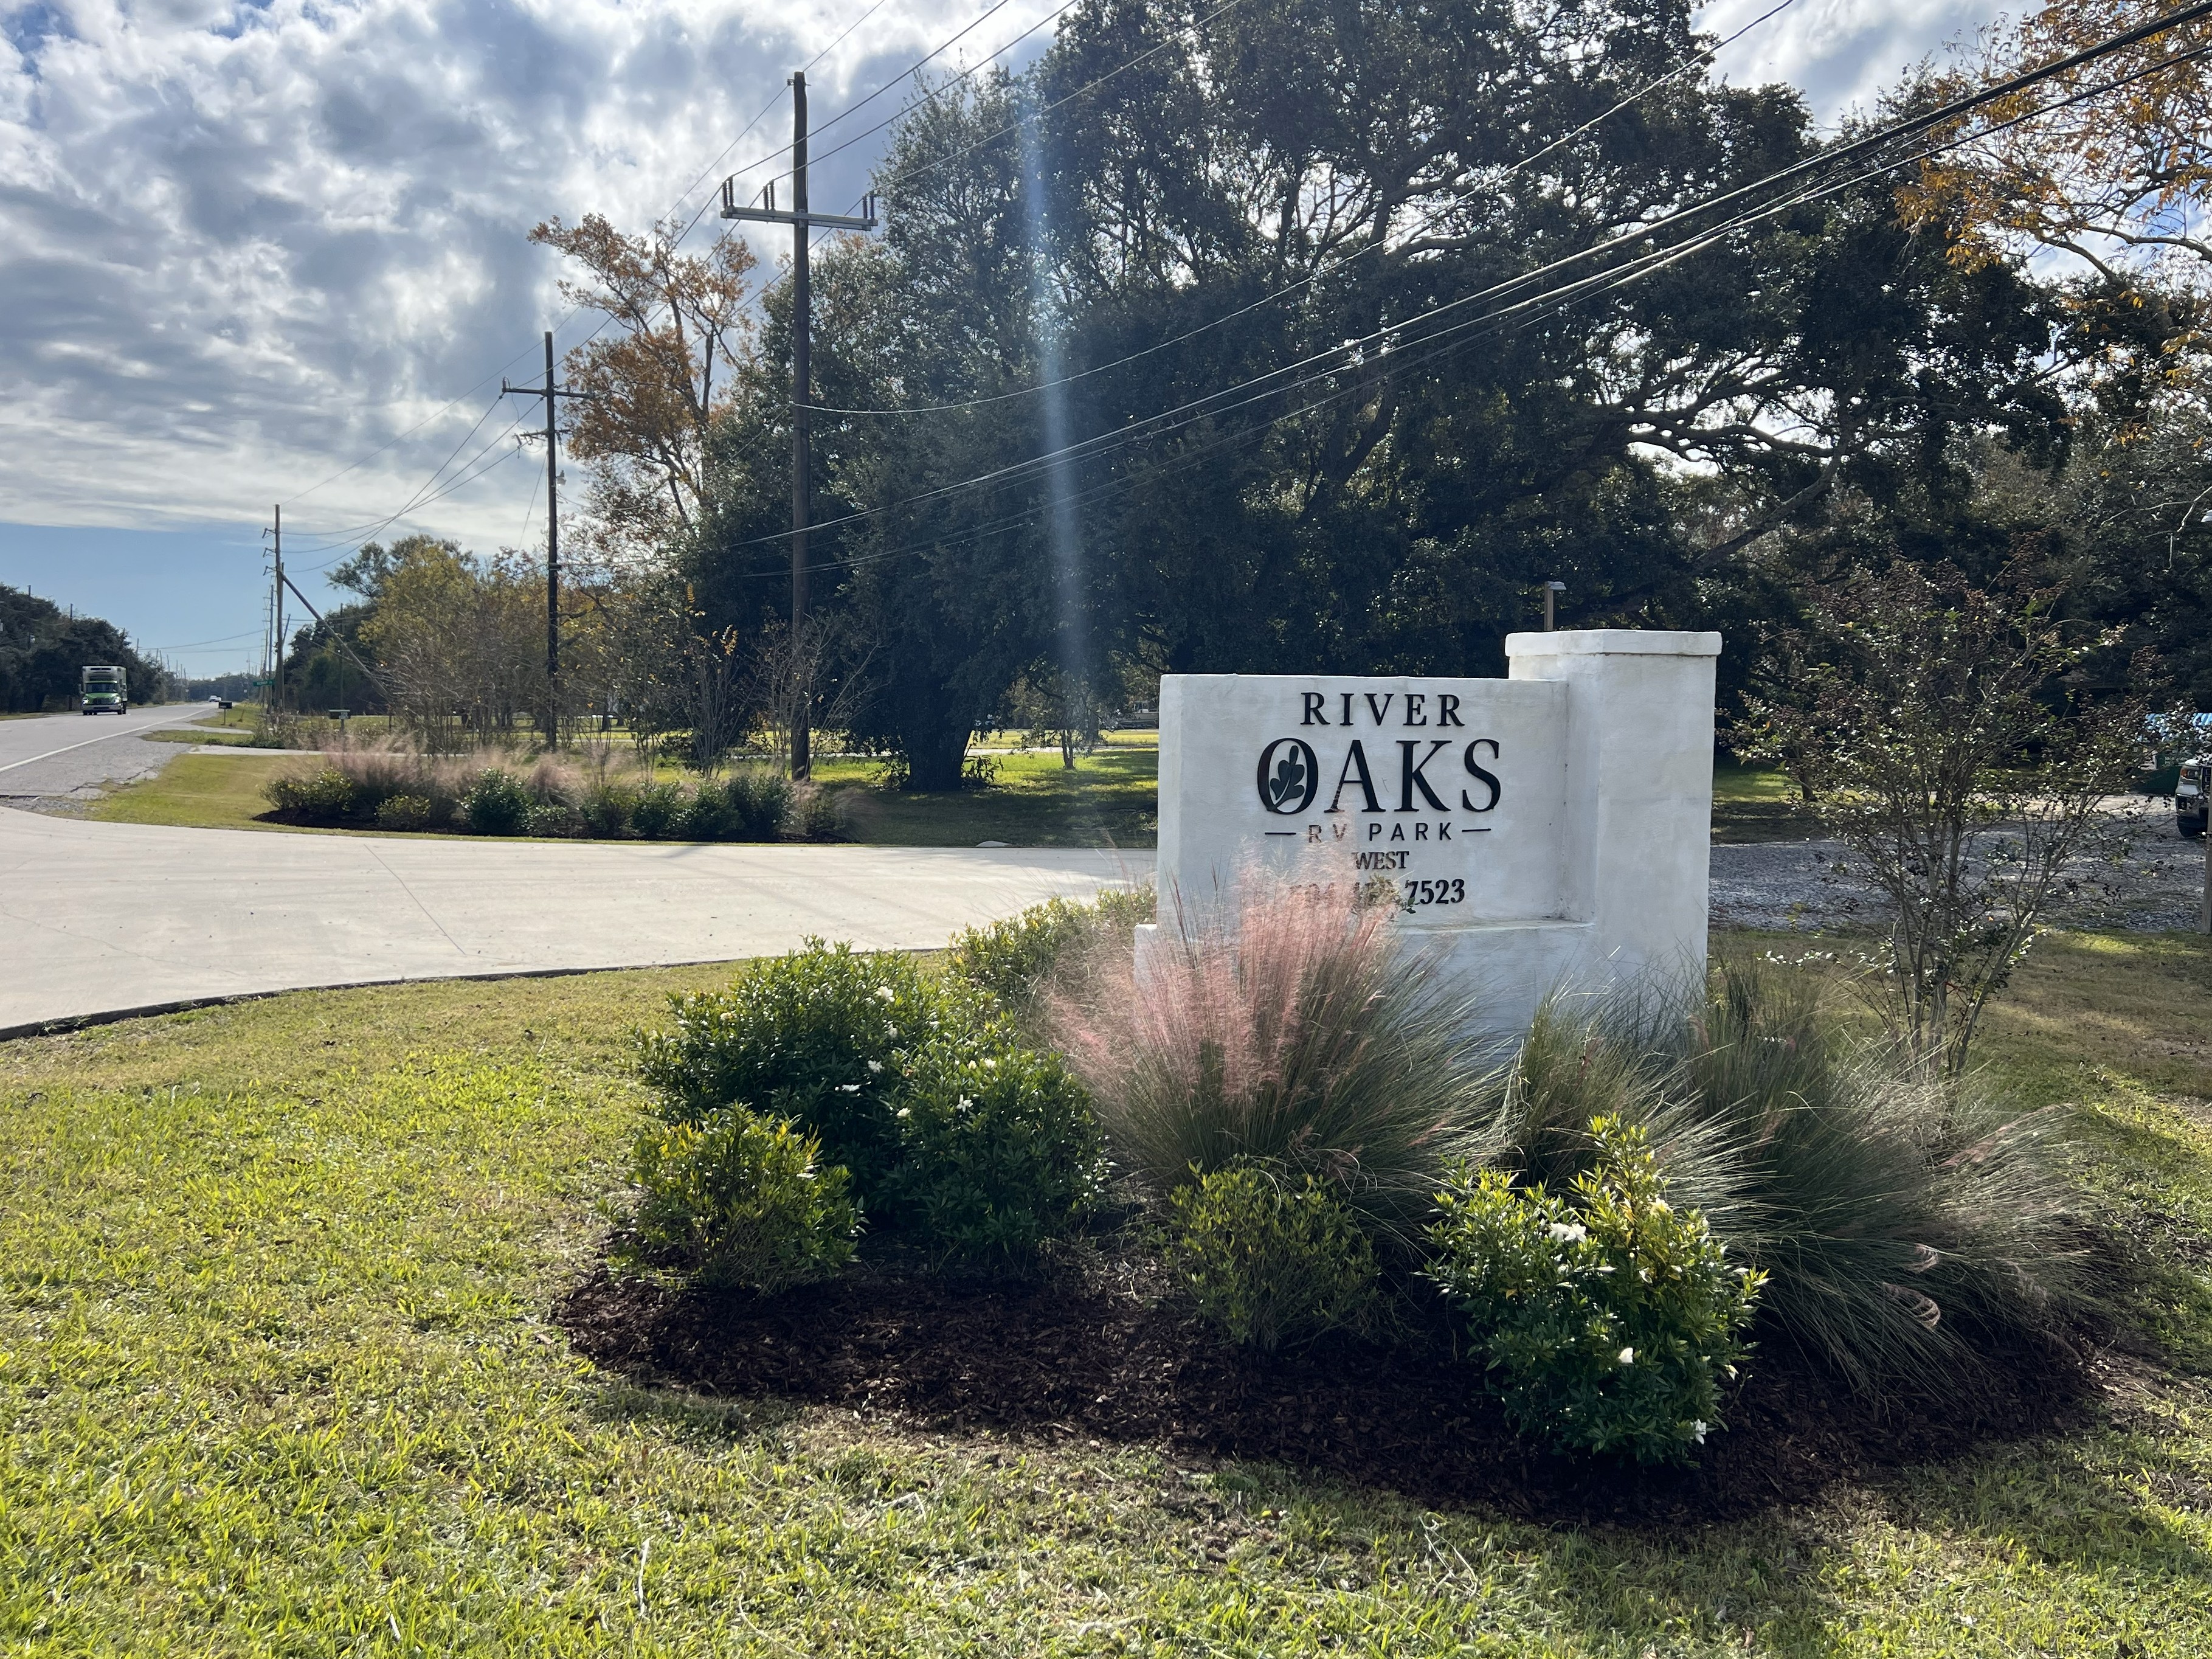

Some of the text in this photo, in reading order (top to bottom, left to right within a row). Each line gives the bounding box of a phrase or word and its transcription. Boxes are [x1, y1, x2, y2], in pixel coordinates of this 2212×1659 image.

[1301, 692, 1465, 727] RIVER
[1257, 738, 1501, 814] OAKS
[1308, 822, 1452, 843] RV PARK
[1353, 851, 1409, 870] WEST
